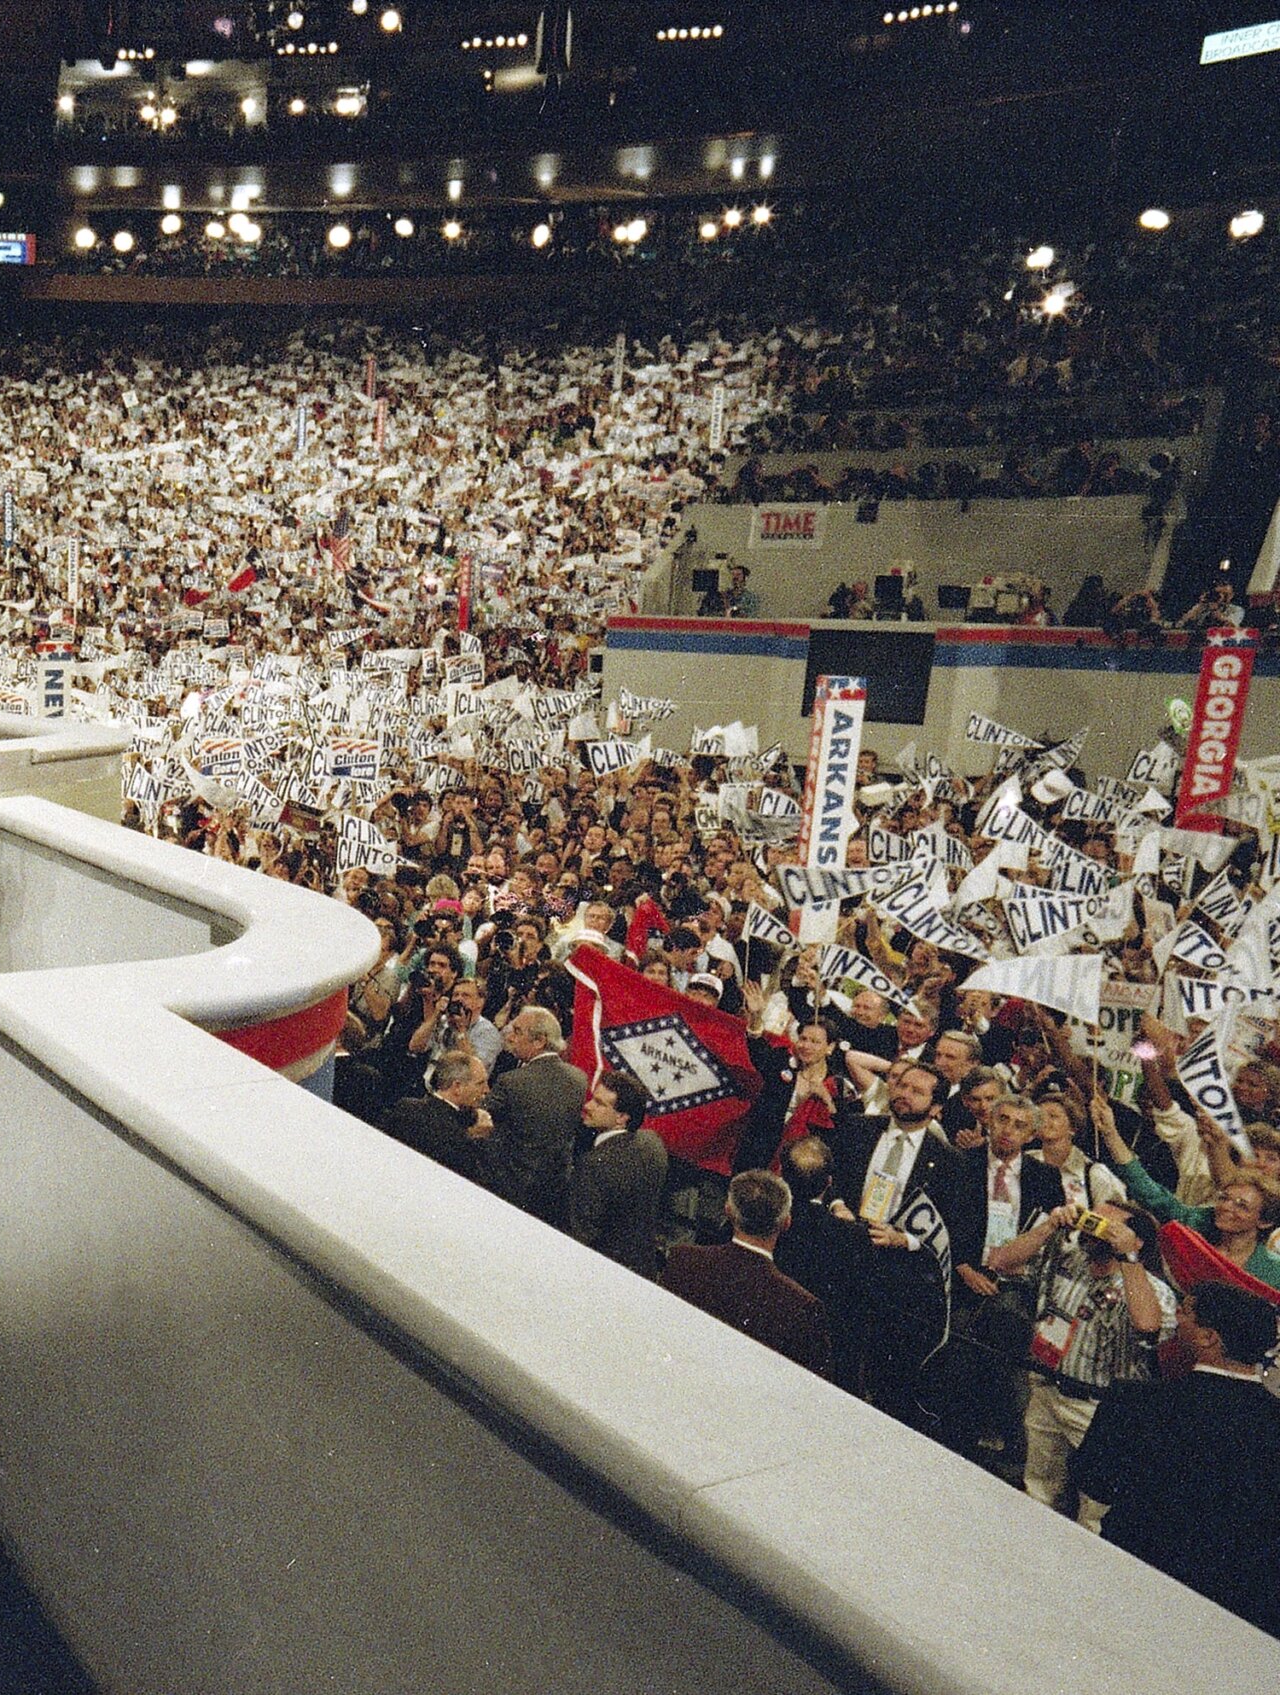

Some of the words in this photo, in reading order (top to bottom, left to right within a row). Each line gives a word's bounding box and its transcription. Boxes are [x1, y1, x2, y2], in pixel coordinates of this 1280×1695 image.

[760, 511, 816, 534] TIME
[322, 702, 350, 723] CLIN
[458, 694, 485, 716] CLIN
[1191, 655, 1242, 796] GEORGIA
[203, 751, 240, 764] linton
[334, 753, 376, 766] Clinton
[239, 770, 280, 808] CLINTO
[438, 766, 467, 789] CLIN
[817, 709, 854, 865] ARKANS
[1067, 790, 1113, 819] CLIN
[345, 817, 382, 845] CLIN
[988, 805, 1049, 850] CLINT
[339, 840, 408, 870] CLINTON
[871, 829, 914, 862] CLIN
[1008, 895, 1109, 947] CLINTON
[1179, 978, 1274, 1013] NTON
[640, 1042, 697, 1075] ARKANSAS
